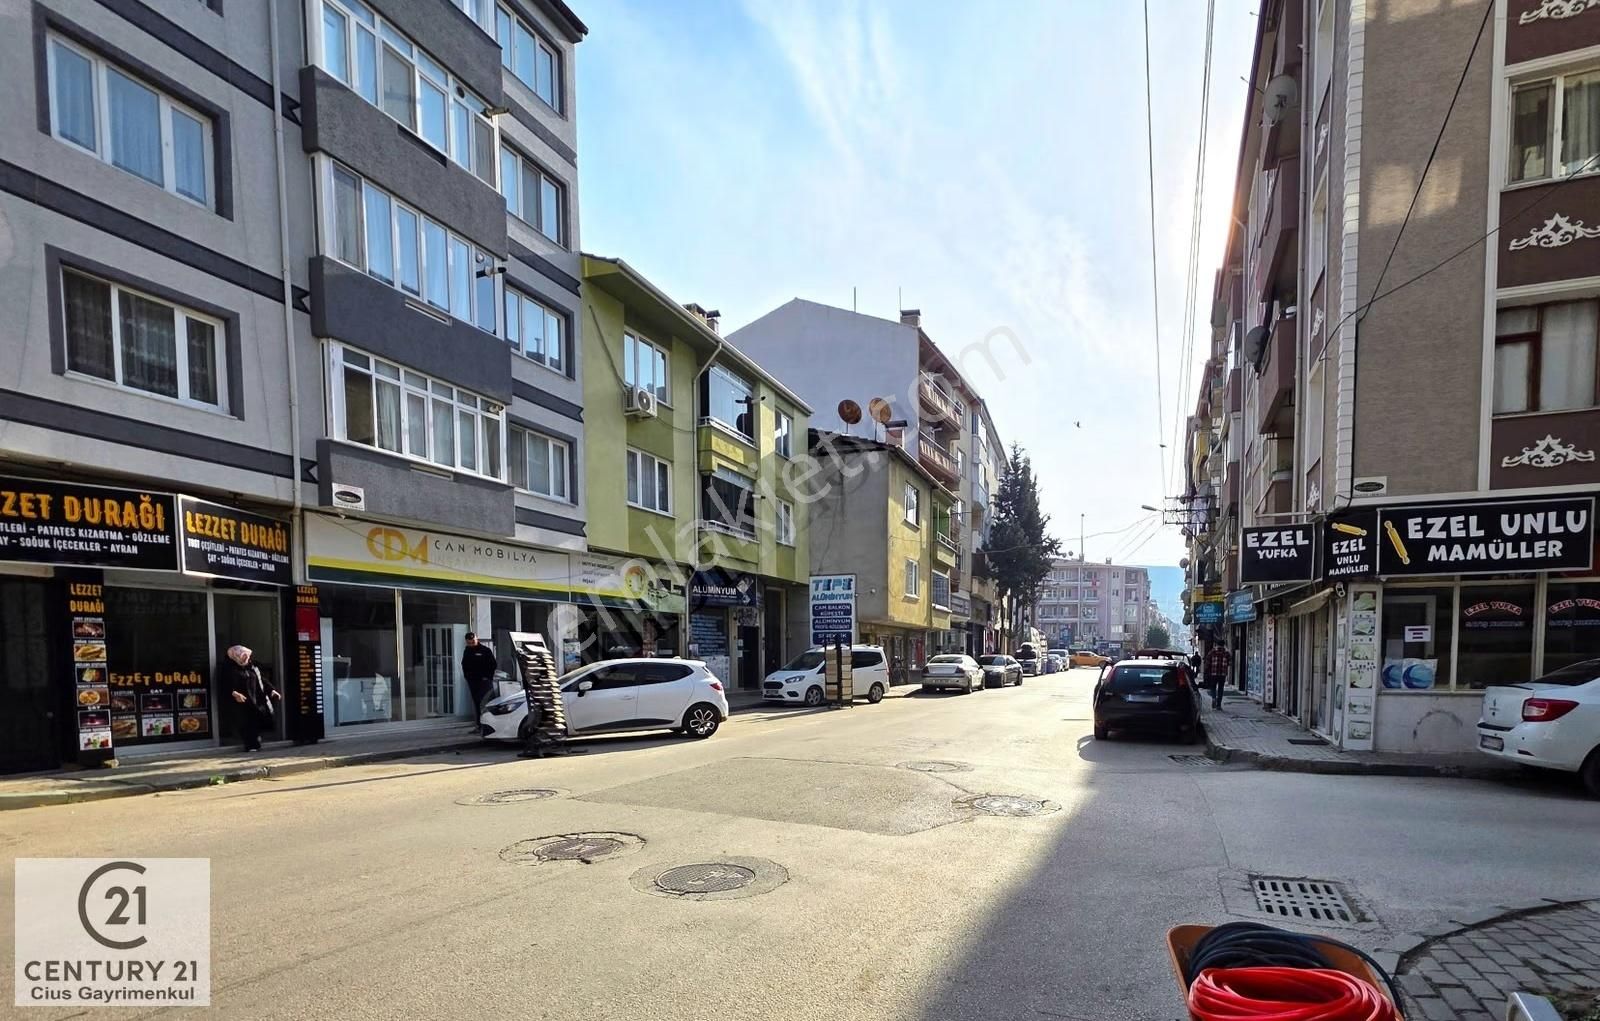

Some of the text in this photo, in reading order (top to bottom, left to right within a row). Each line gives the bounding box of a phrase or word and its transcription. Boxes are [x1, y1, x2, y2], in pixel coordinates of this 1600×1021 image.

[0, 491, 165, 531] ZET DURAĞI
[186, 511, 287, 552] LEZZET DURAĞI
[1407, 510, 1587, 539] EZEL UNLU
[37, 525, 76, 537] PATATES
[78, 528, 123, 541] KIZARTMA
[132, 531, 170, 544] GÖZLEME
[1246, 530, 1309, 548] EZEL
[20, 535, 51, 549] SOĞUK
[53, 537, 101, 552] İÇECEKLER
[110, 543, 138, 554] AYRAN
[434, 540, 465, 553] CAN
[1332, 538, 1366, 555] EZEL
[1427, 539, 1563, 562] MAMÜLLER
[1257, 548, 1298, 560] YUFKA
[1336, 554, 1360, 566] UNLU
[1328, 564, 1369, 577] MAMÜLLER
[70, 583, 102, 596] LEZZET
[70, 599, 105, 613] DURAĞI
[110, 672, 151, 686] EZZET
